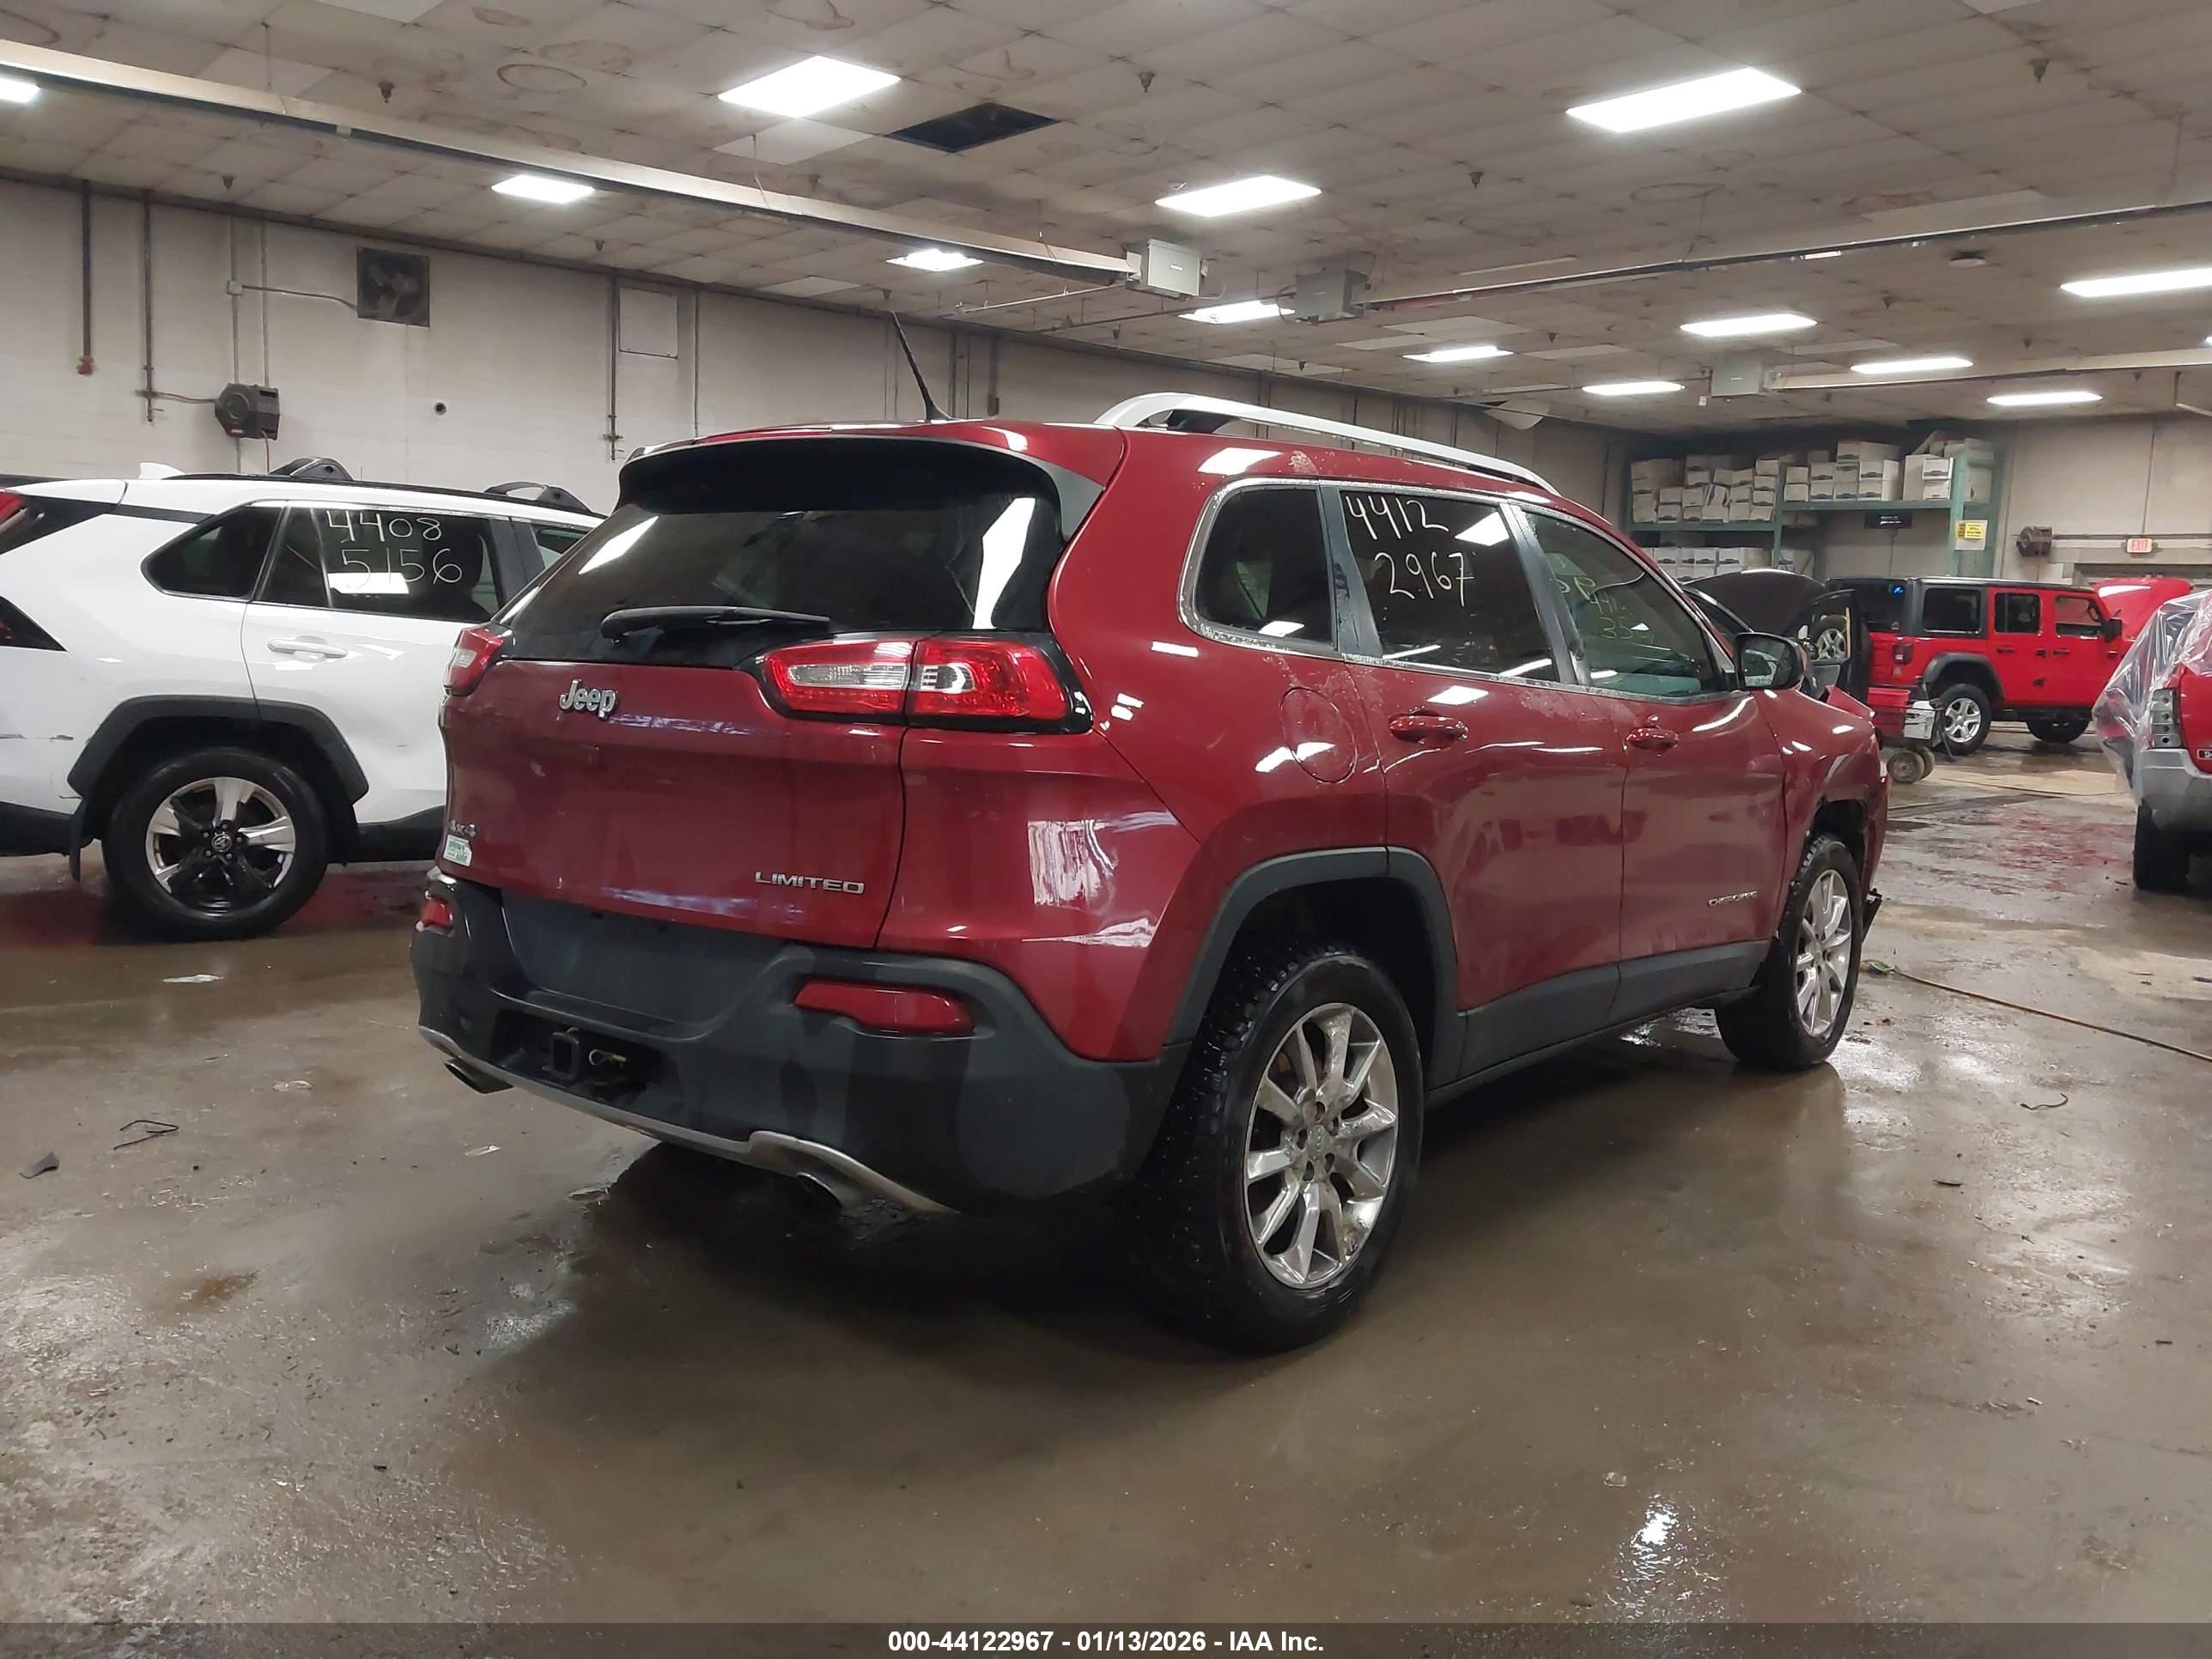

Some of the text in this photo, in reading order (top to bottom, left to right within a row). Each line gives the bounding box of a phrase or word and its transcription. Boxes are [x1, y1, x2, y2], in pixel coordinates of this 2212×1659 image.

[326, 510, 442, 542] 4408
[1346, 495, 1449, 540] 4412
[341, 548, 463, 589] 5156
[1374, 551, 1475, 608] 2967
[559, 678, 617, 719] Jeep
[755, 871, 866, 895] LIMITED
